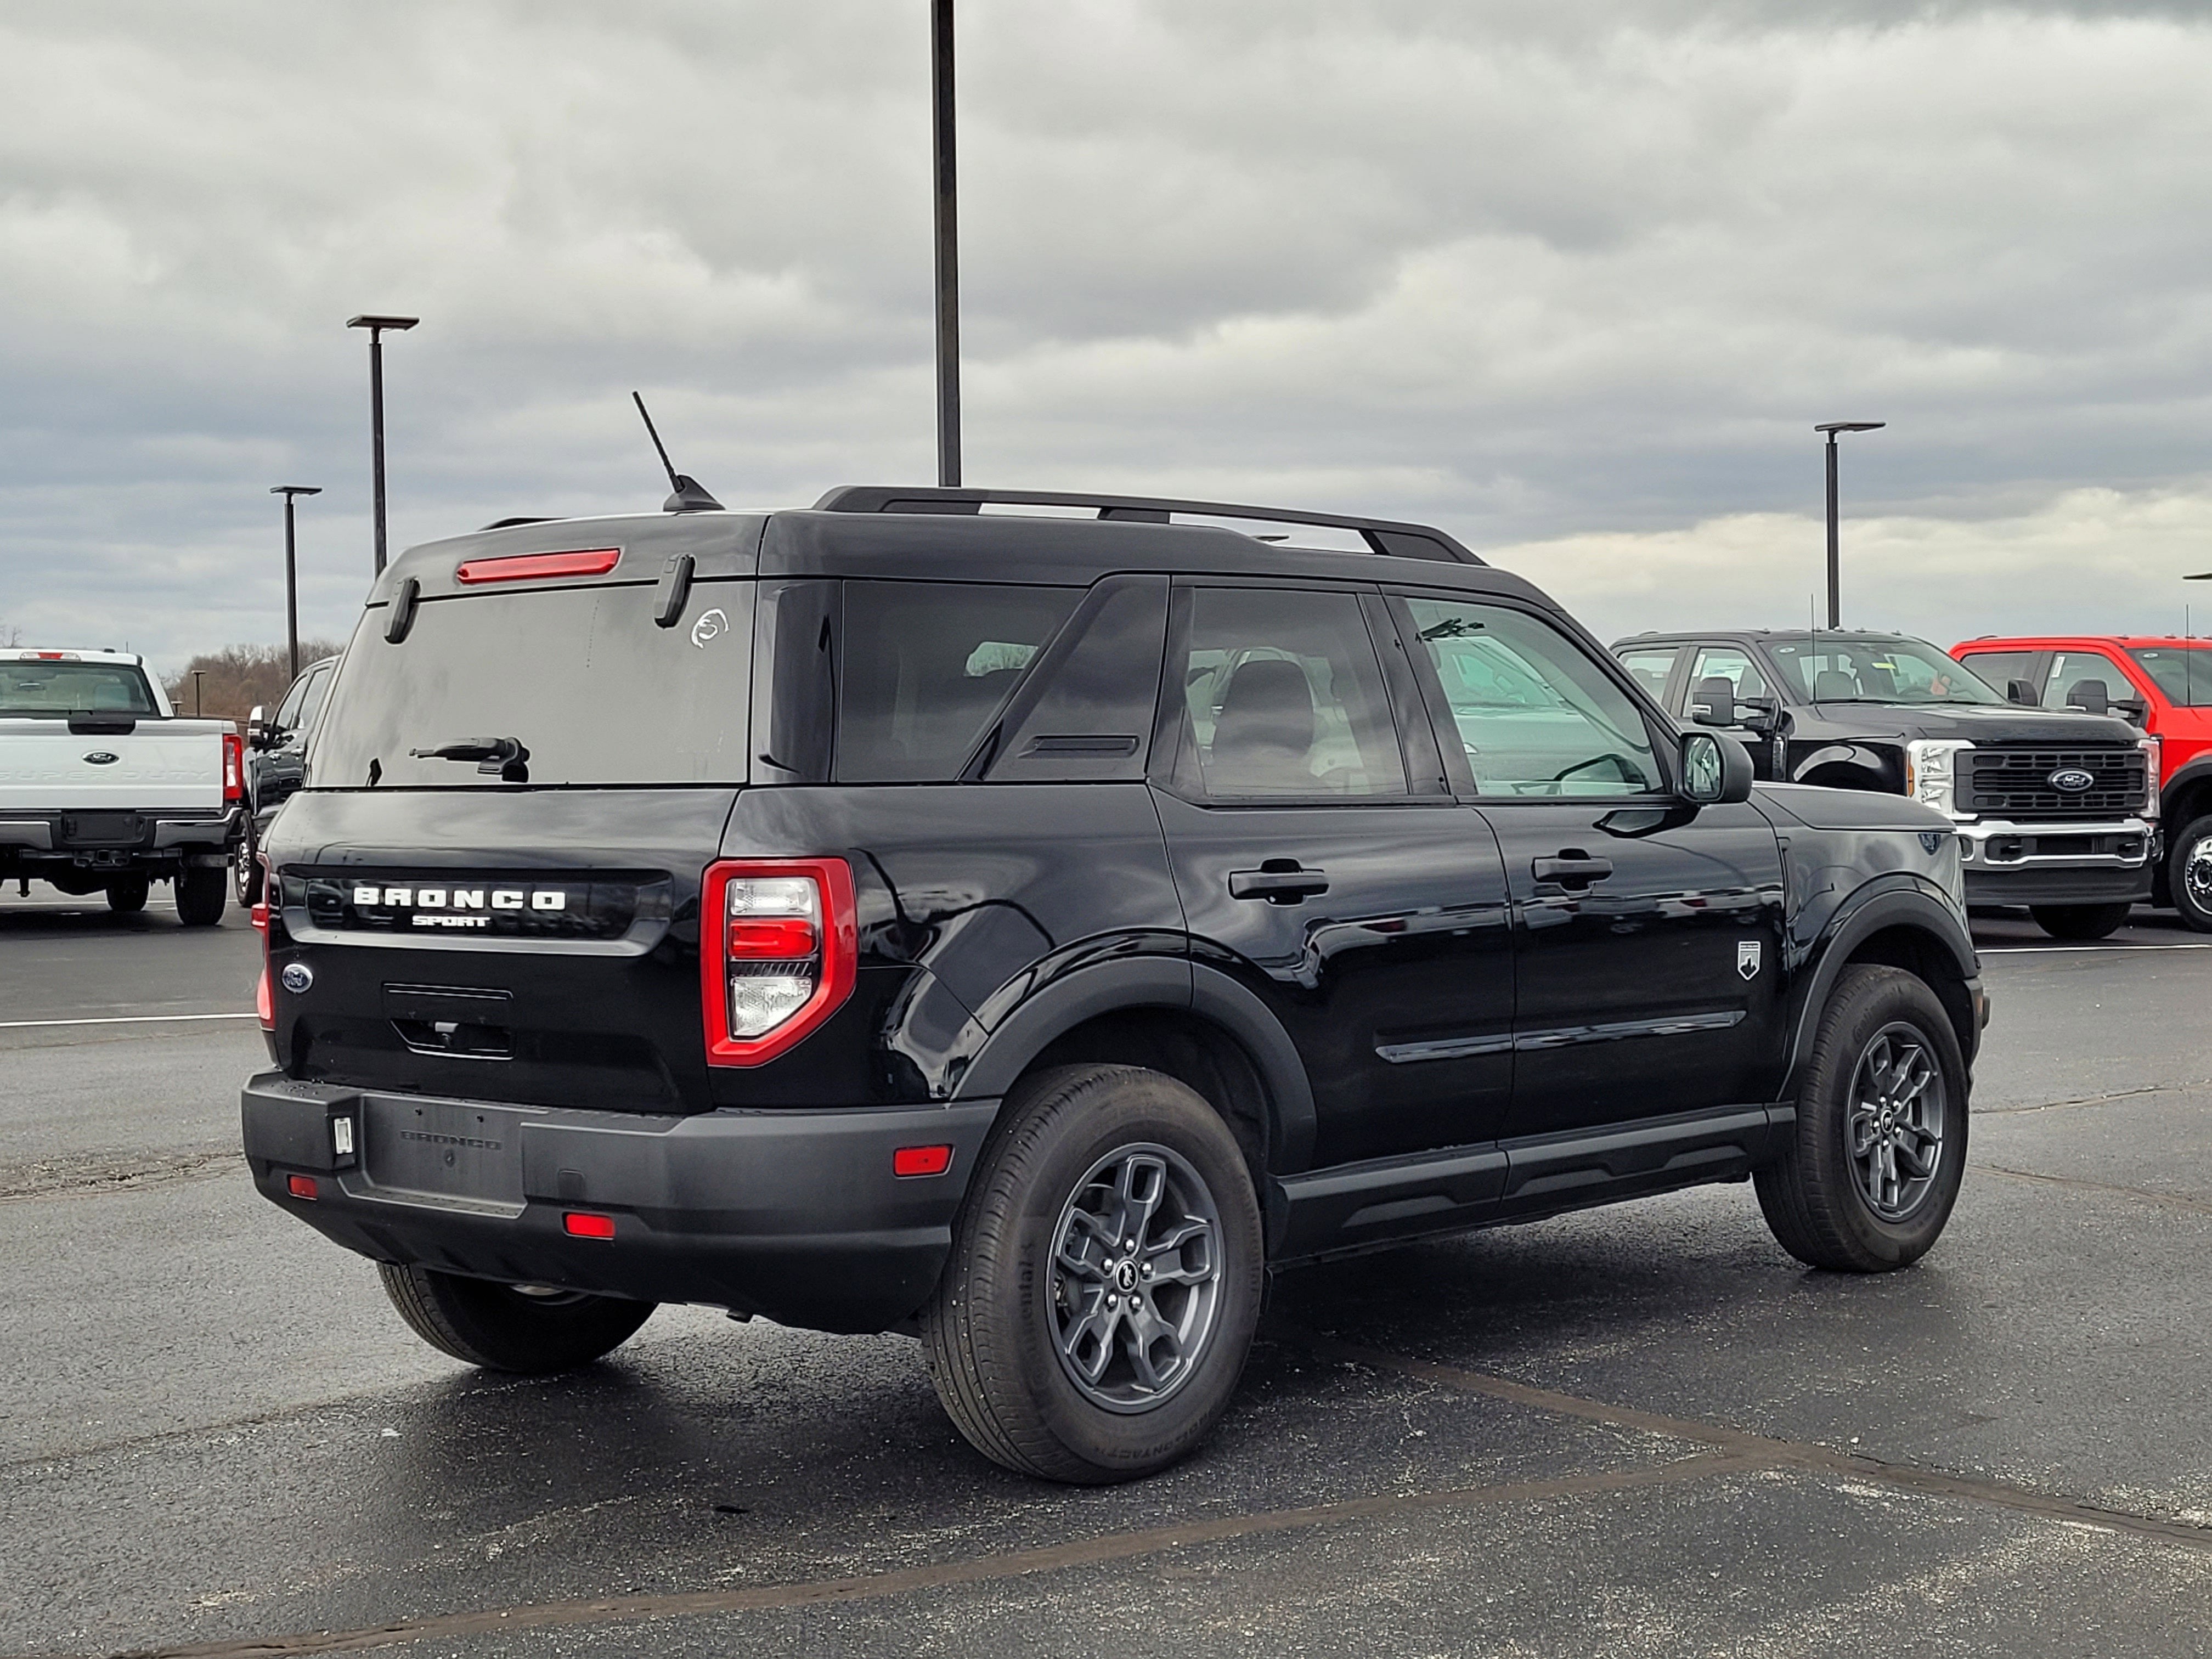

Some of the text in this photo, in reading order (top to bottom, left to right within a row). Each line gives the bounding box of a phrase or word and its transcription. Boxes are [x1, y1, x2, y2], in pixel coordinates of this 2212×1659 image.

[120, 770, 210, 780] DUTY
[353, 887, 566, 911] BRONCO
[412, 915, 490, 928] SPORT
[400, 1130, 502, 1151] BRONCO
